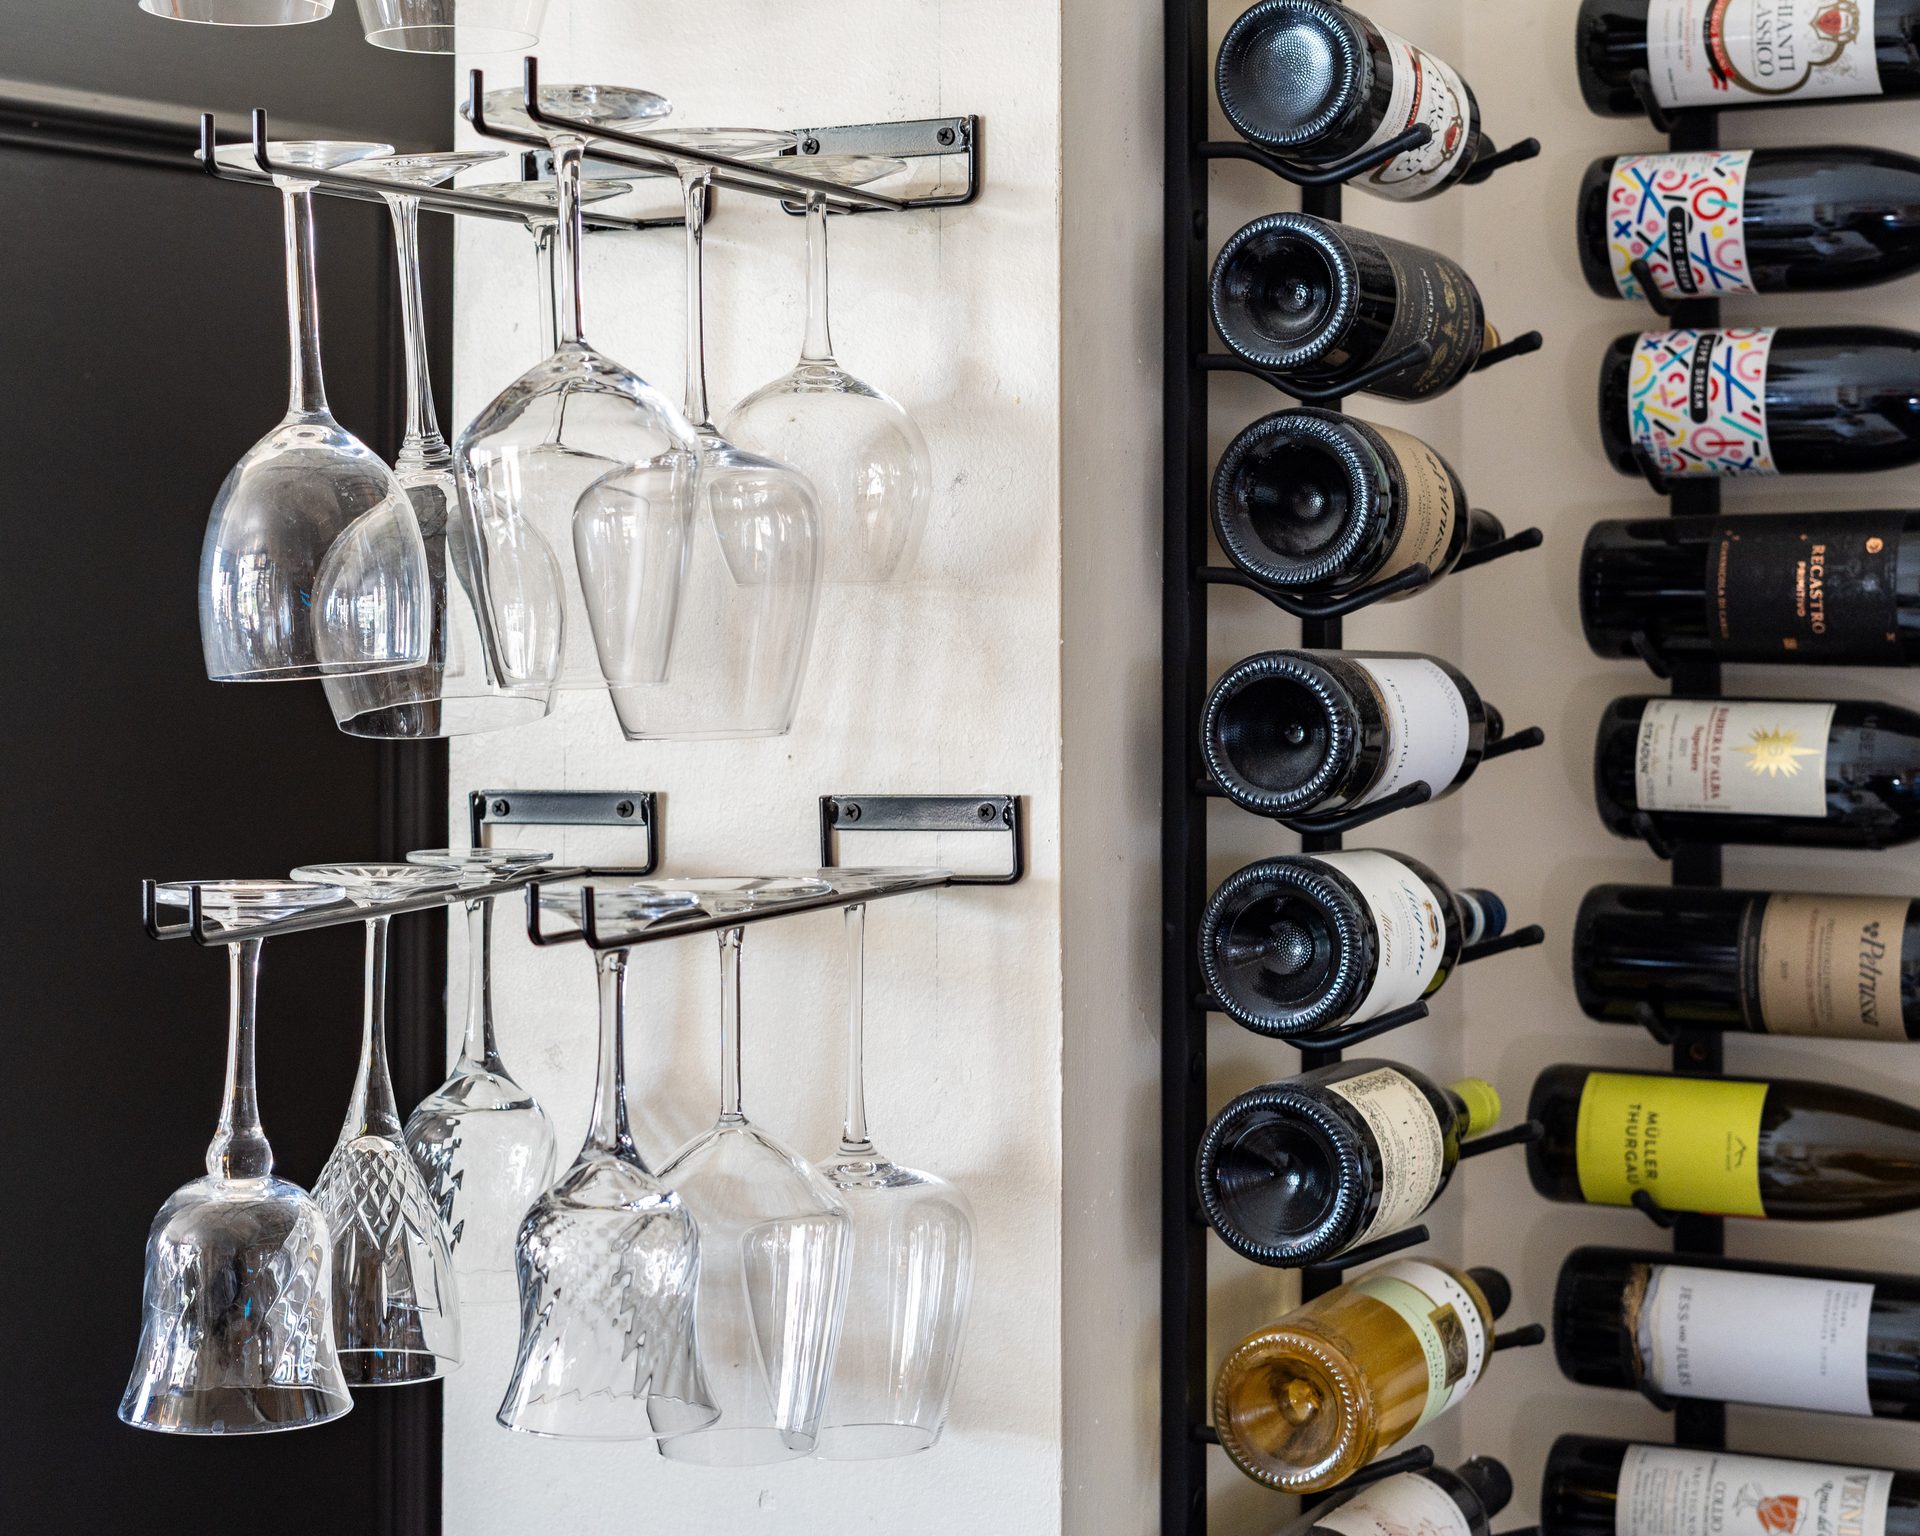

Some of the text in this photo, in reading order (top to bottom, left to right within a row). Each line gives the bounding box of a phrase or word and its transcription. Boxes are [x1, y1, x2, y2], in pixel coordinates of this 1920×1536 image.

[1756, 0, 1775, 77] ASSICO
[1777, 0, 1796, 72] HIANTI
[1672, 222, 1685, 254] PIPE
[1417, 264, 1435, 314] NERO
[1694, 338, 1710, 410] PIPE DREAM
[1809, 543, 1827, 635] RECASTRO
[1384, 677, 1406, 714] JESS
[1624, 1103, 1642, 1185] THURGAU
[1644, 1112, 1662, 1181] MÜLLER
[1676, 1286, 1693, 1322] JESS
[1675, 1345, 1693, 1388] JULES
[1686, 1465, 1704, 1536] SAUVIGNO
[1709, 1481, 1727, 1534] COLLIO
[1838, 1472, 1870, 1536] VENI
